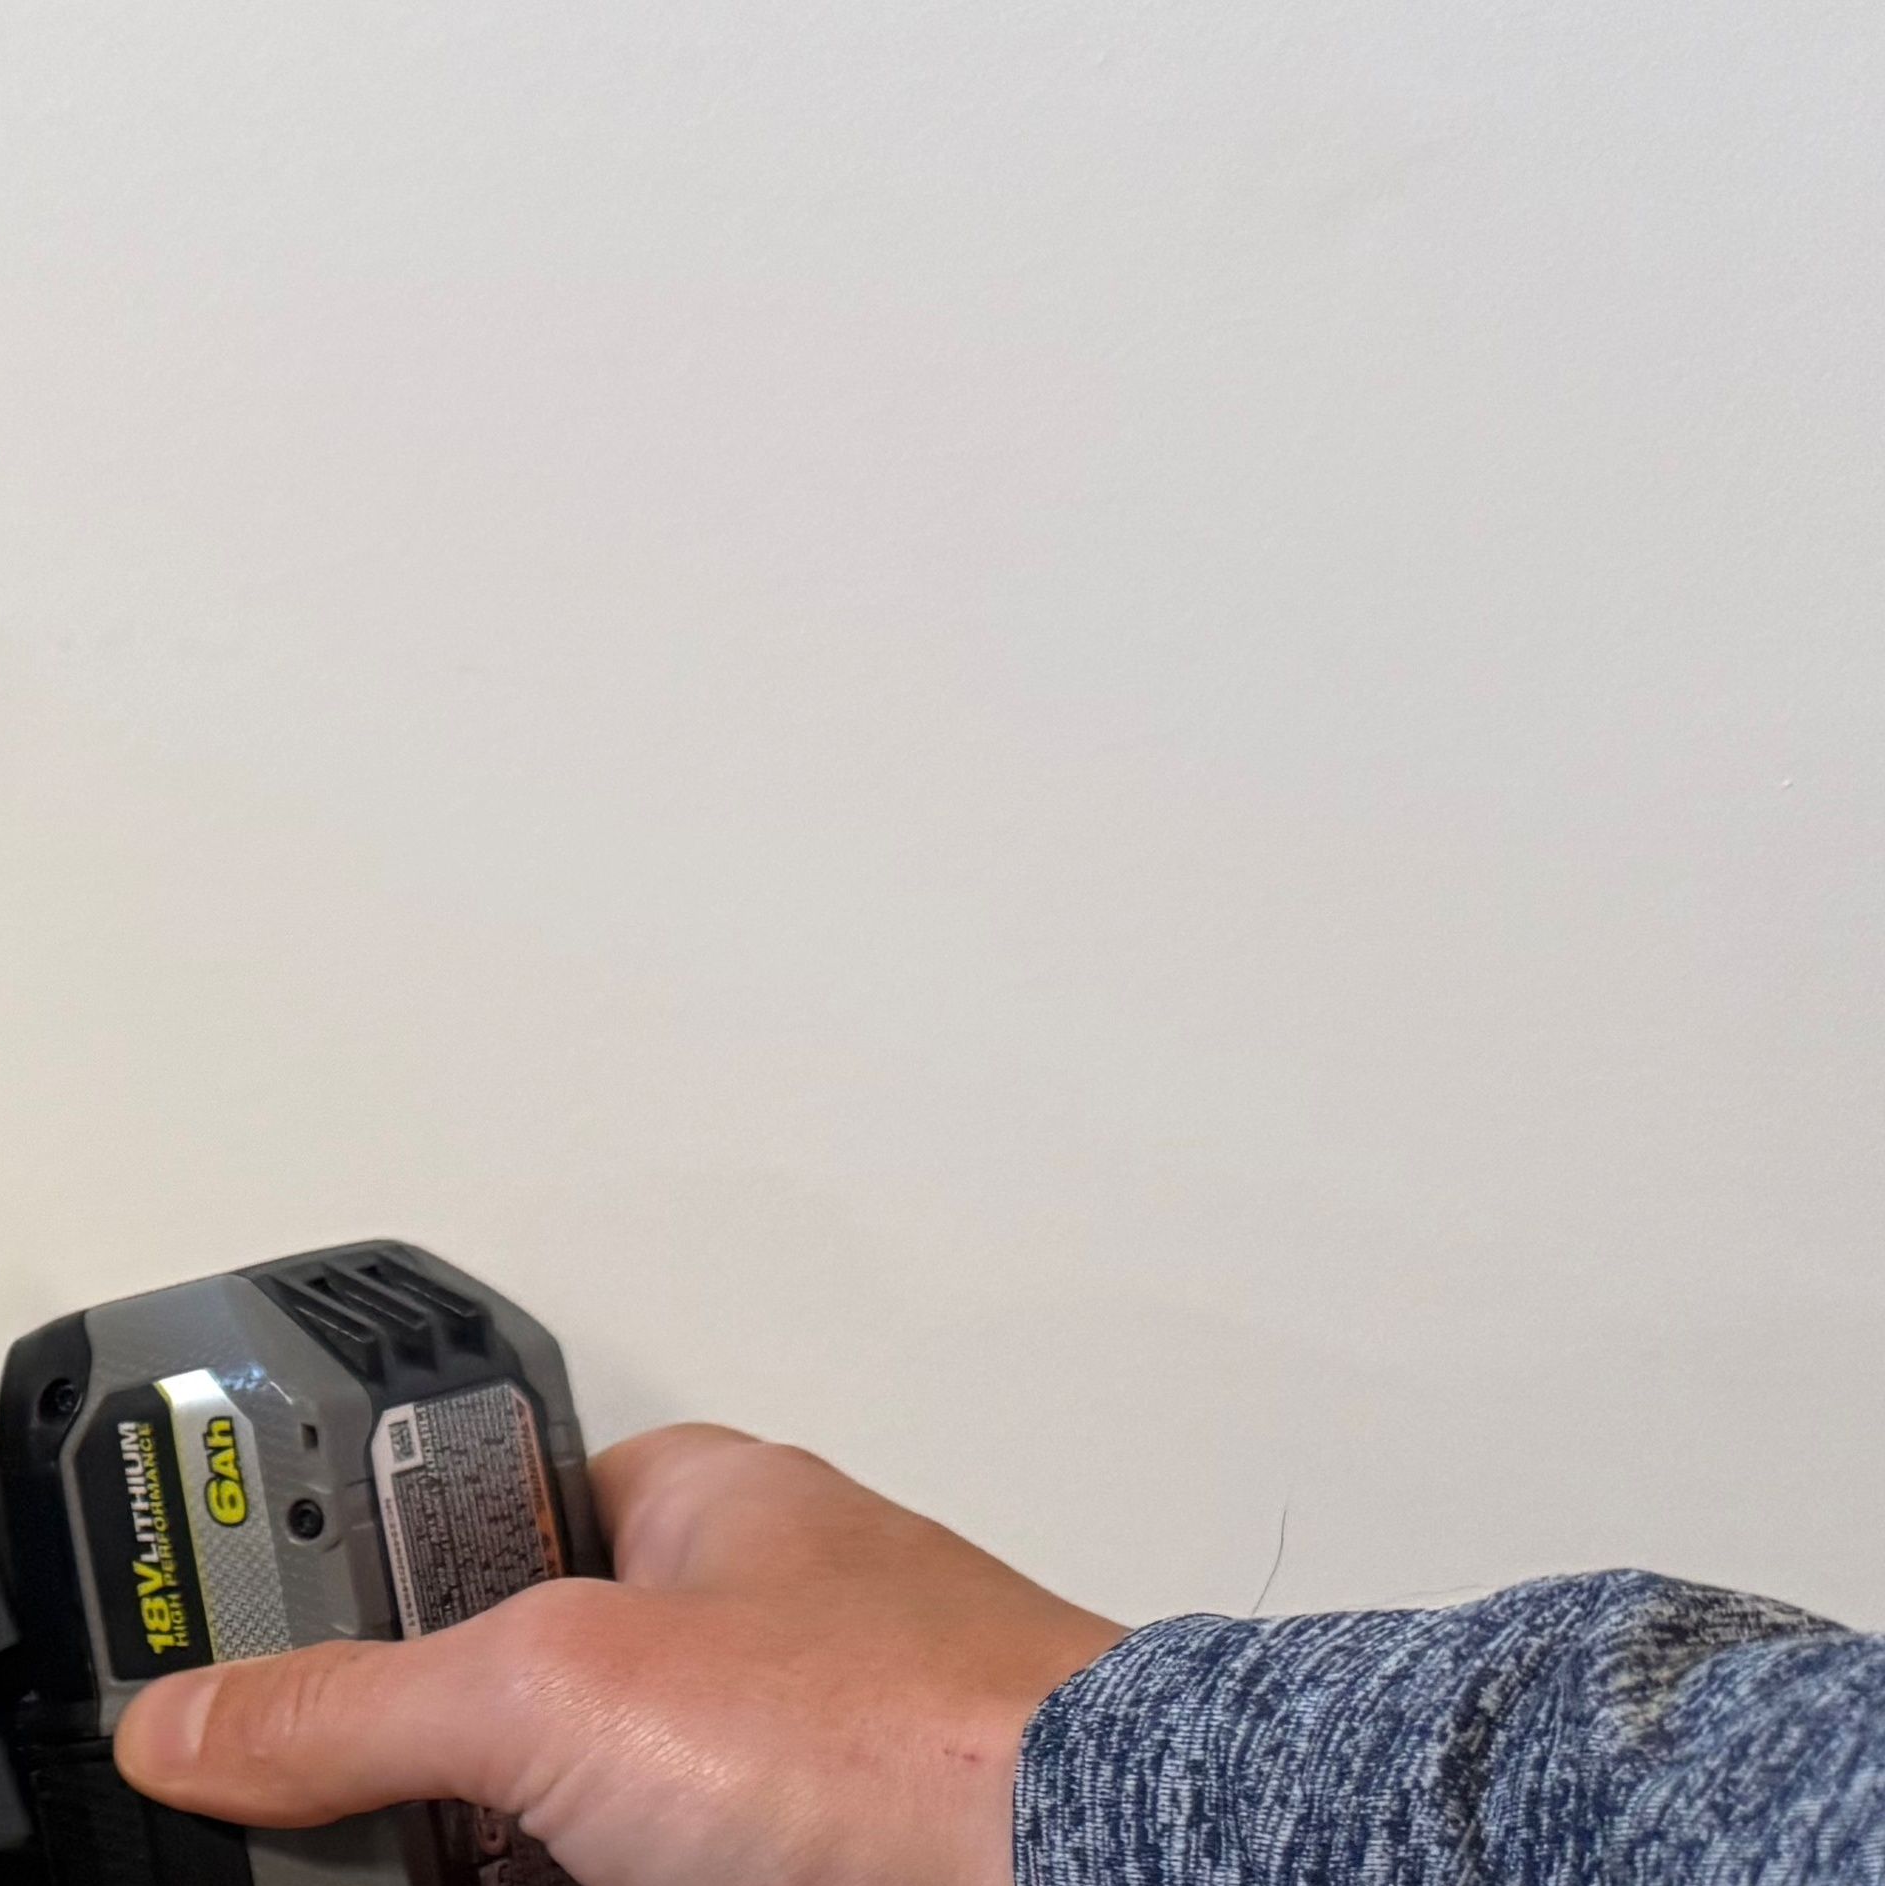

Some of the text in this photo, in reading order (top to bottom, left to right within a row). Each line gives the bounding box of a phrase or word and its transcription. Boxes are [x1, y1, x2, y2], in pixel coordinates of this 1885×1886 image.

[137, 1422, 190, 1648] HIGH PERFORMANCE
[203, 1416, 249, 1528] 6Ah
